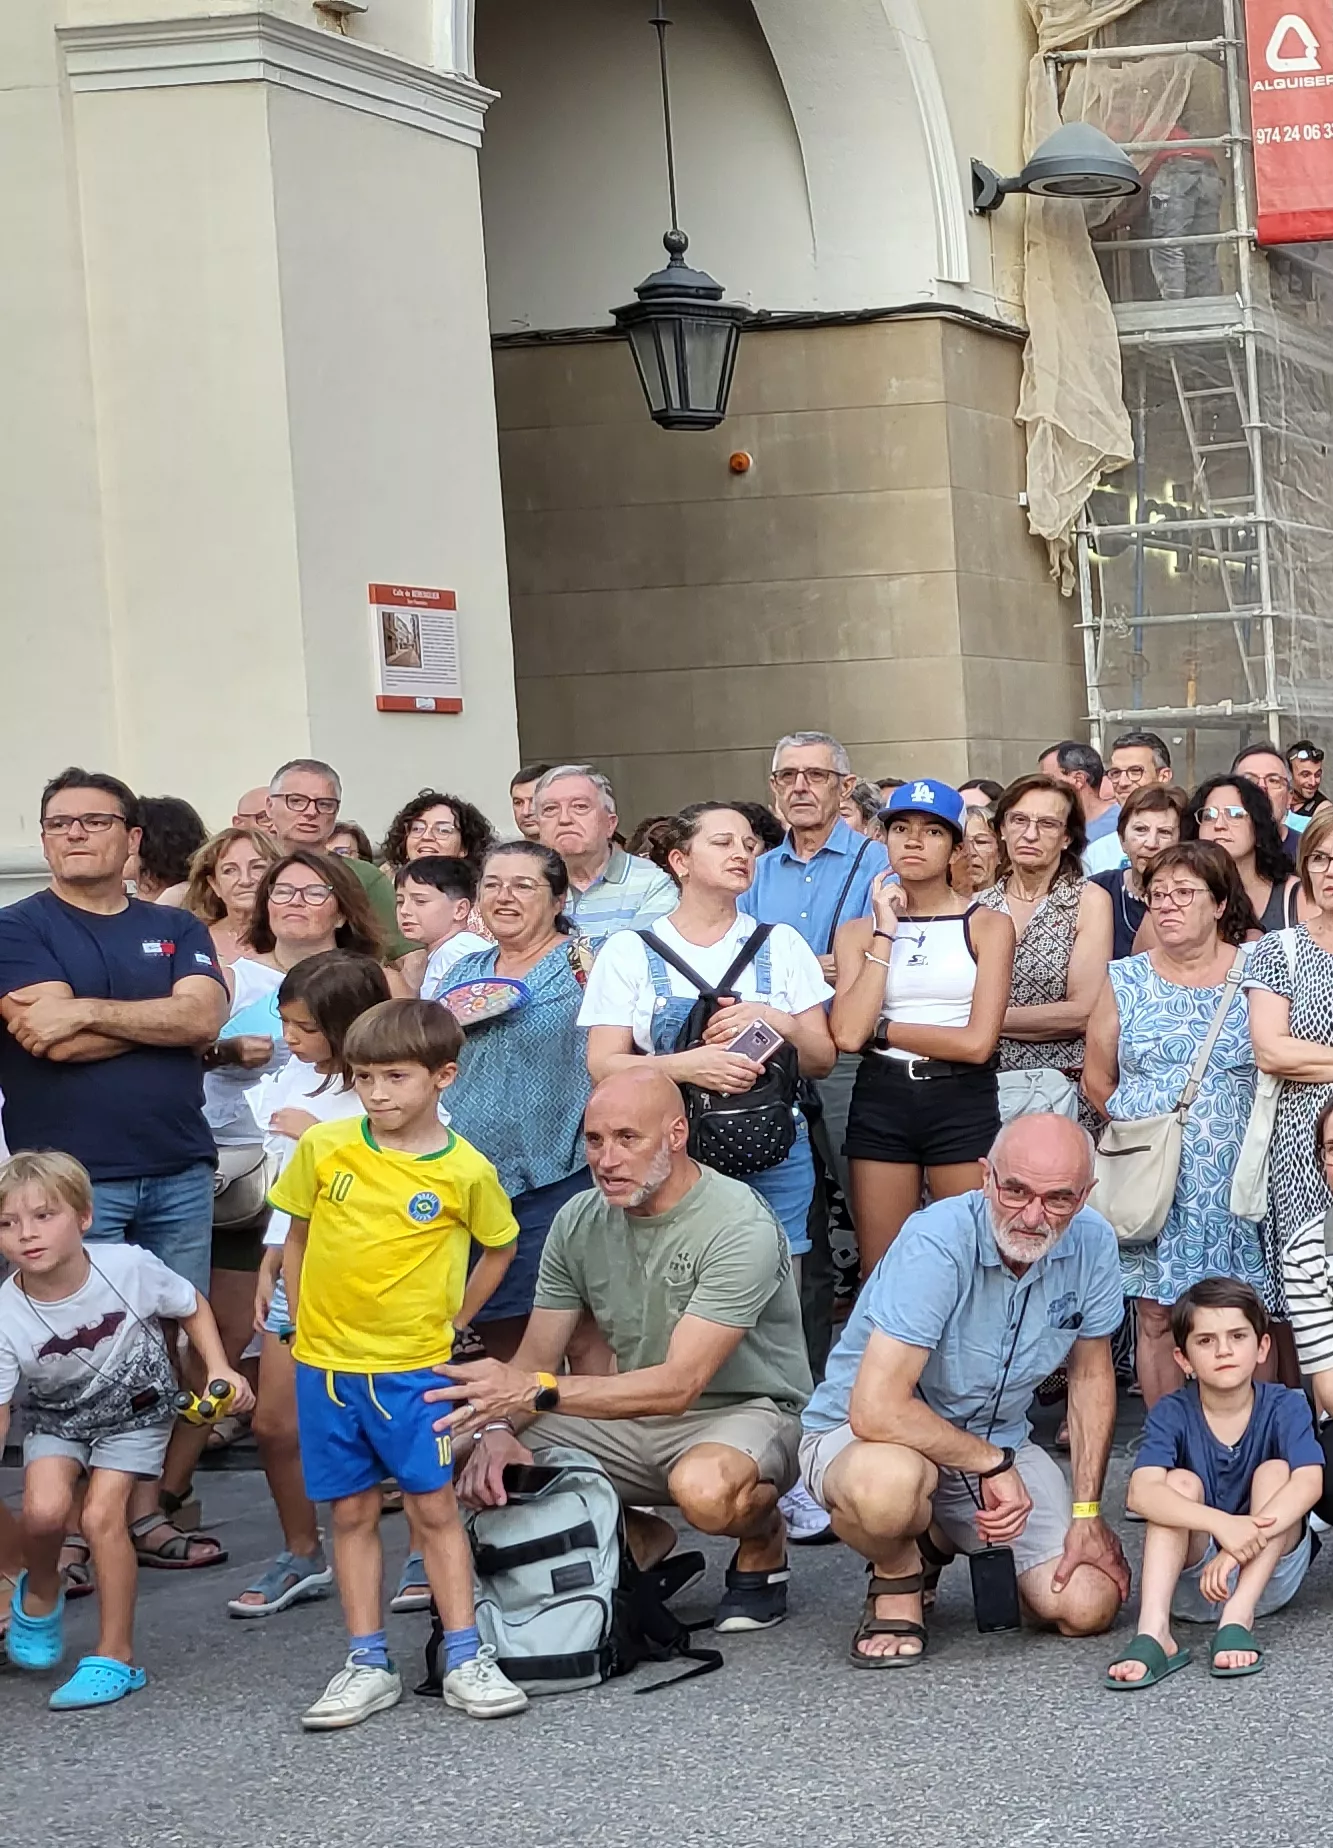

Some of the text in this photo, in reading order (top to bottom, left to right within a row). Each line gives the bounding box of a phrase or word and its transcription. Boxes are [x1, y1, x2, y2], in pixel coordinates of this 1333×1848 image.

[1256, 127, 1281, 145] 974
[1283, 125, 1301, 142] 24
[1303, 123, 1321, 141] 06
[911, 781, 935, 804] LA
[328, 1170, 354, 1202] 10
[435, 1435, 452, 1467] 10
